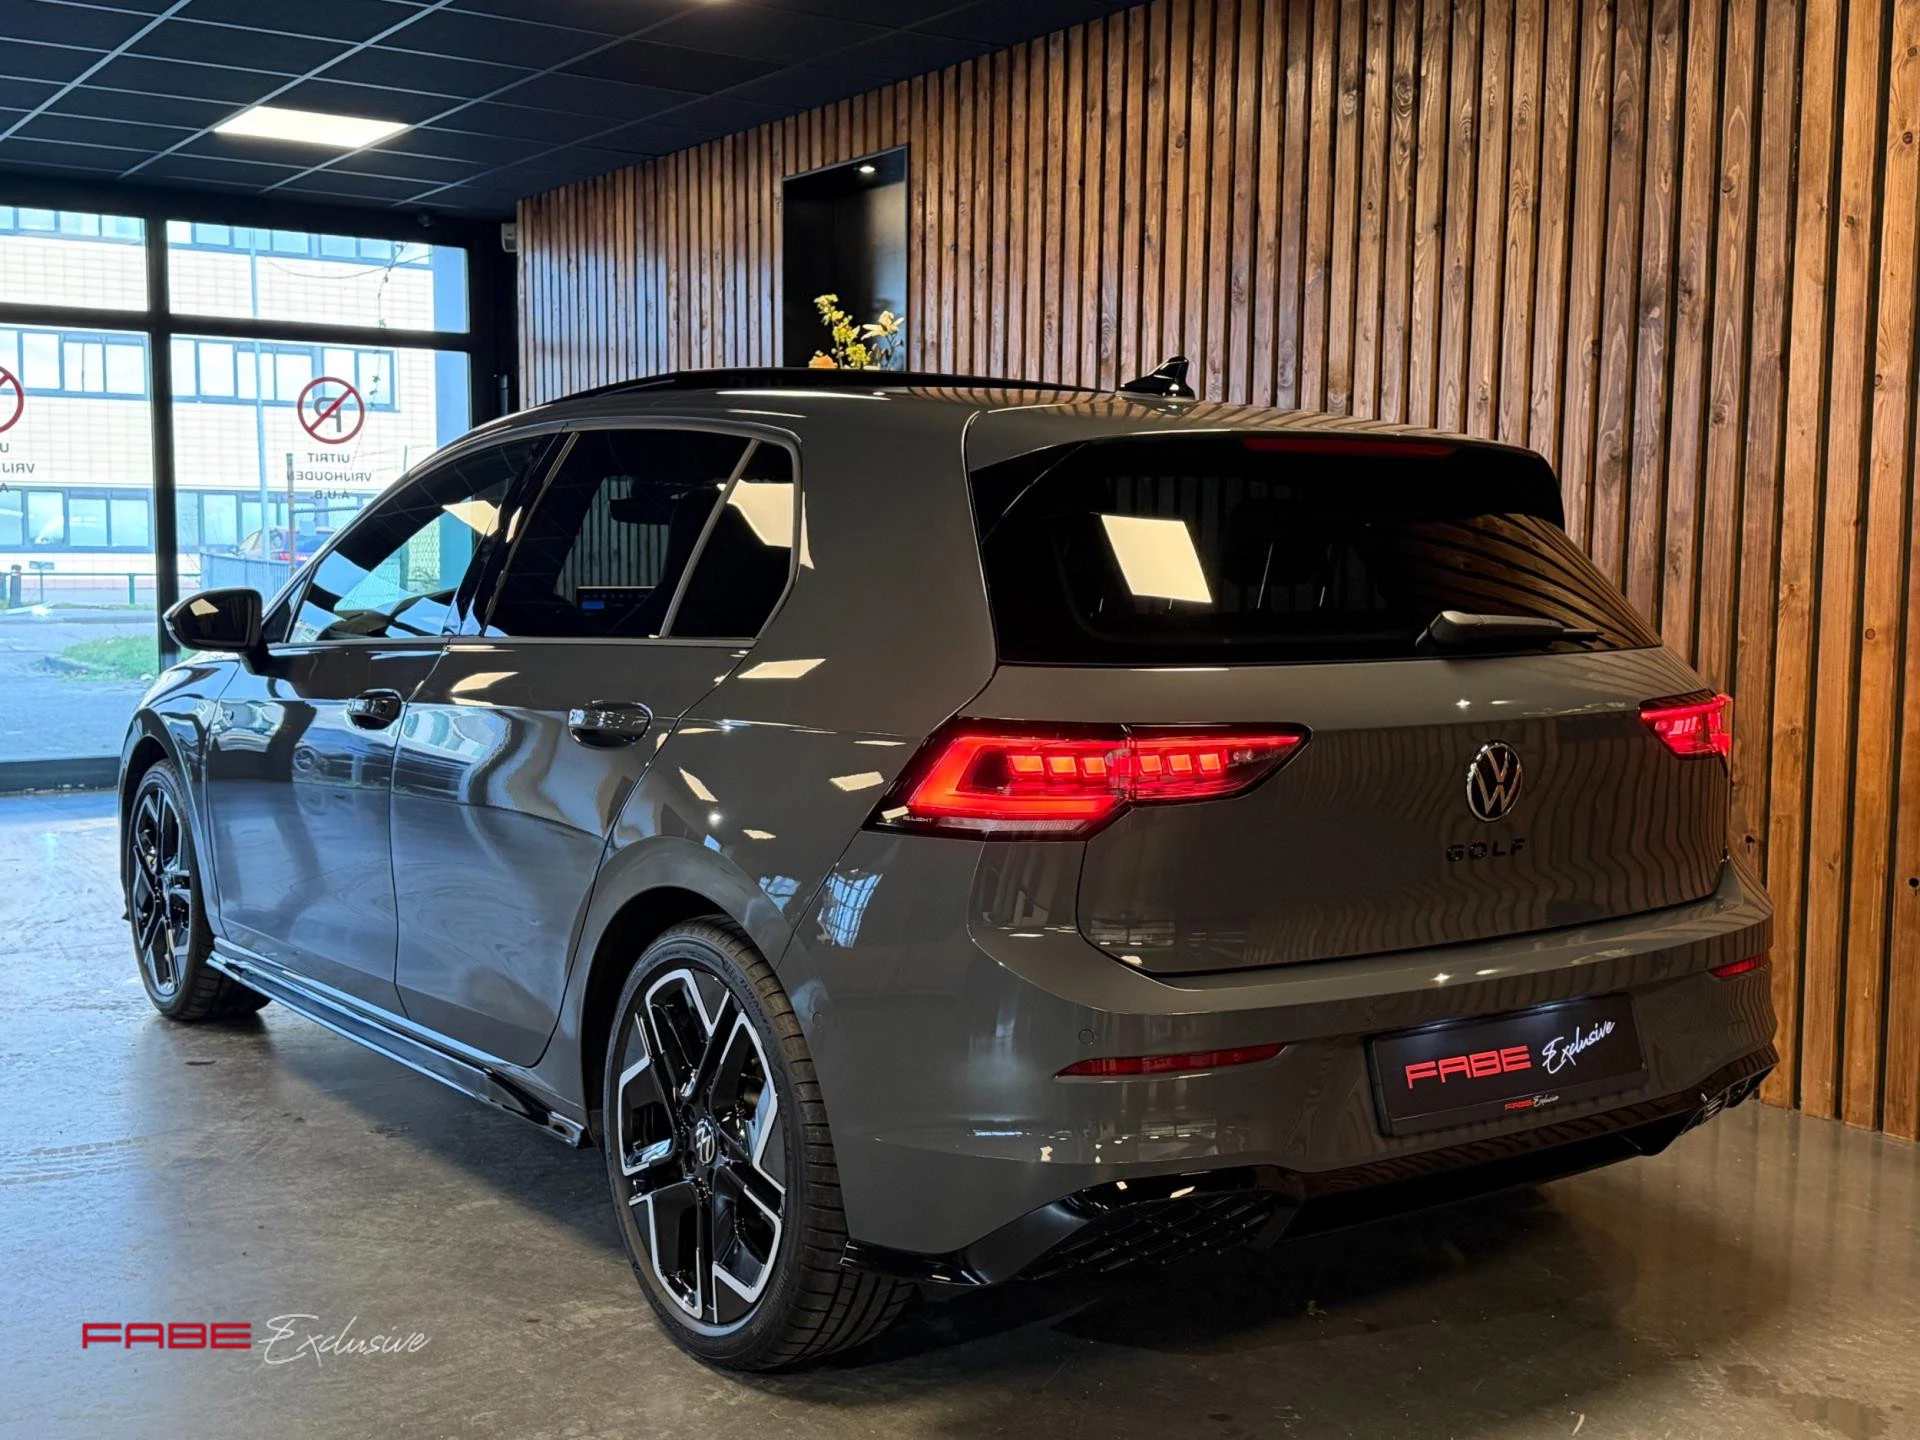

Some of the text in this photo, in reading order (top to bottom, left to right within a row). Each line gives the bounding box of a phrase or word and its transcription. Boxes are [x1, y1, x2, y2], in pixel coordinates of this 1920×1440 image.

[1446, 838, 1525, 862] GOLF
[1405, 1019, 1616, 1089] FABE Exclusive
